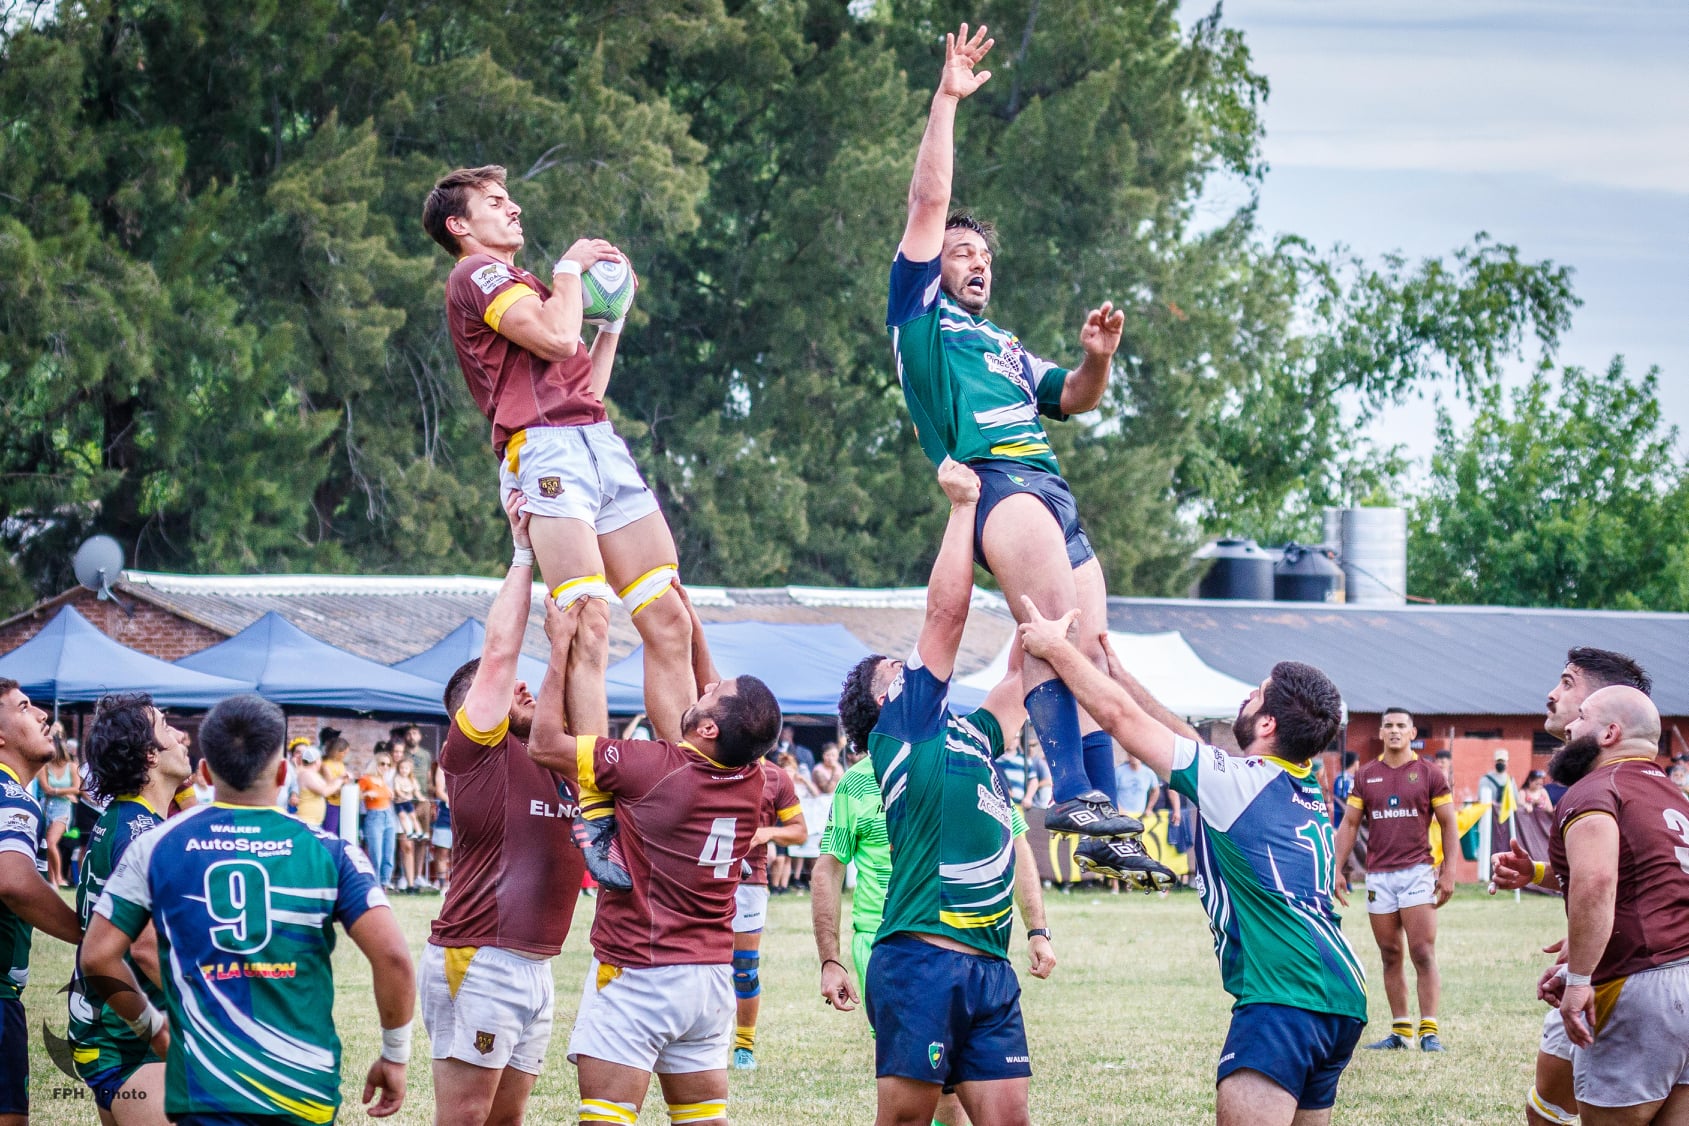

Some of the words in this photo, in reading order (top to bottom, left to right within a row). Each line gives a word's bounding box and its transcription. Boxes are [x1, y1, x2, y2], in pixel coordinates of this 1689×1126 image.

[530, 799, 555, 818] EL
[209, 824, 262, 834] WALKER
[185, 838, 294, 854] AutoSport
[697, 817, 738, 879] 4
[1662, 807, 1689, 875] 3
[203, 859, 273, 955] 9
[217, 962, 241, 980] LA
[243, 962, 297, 979] UNION
